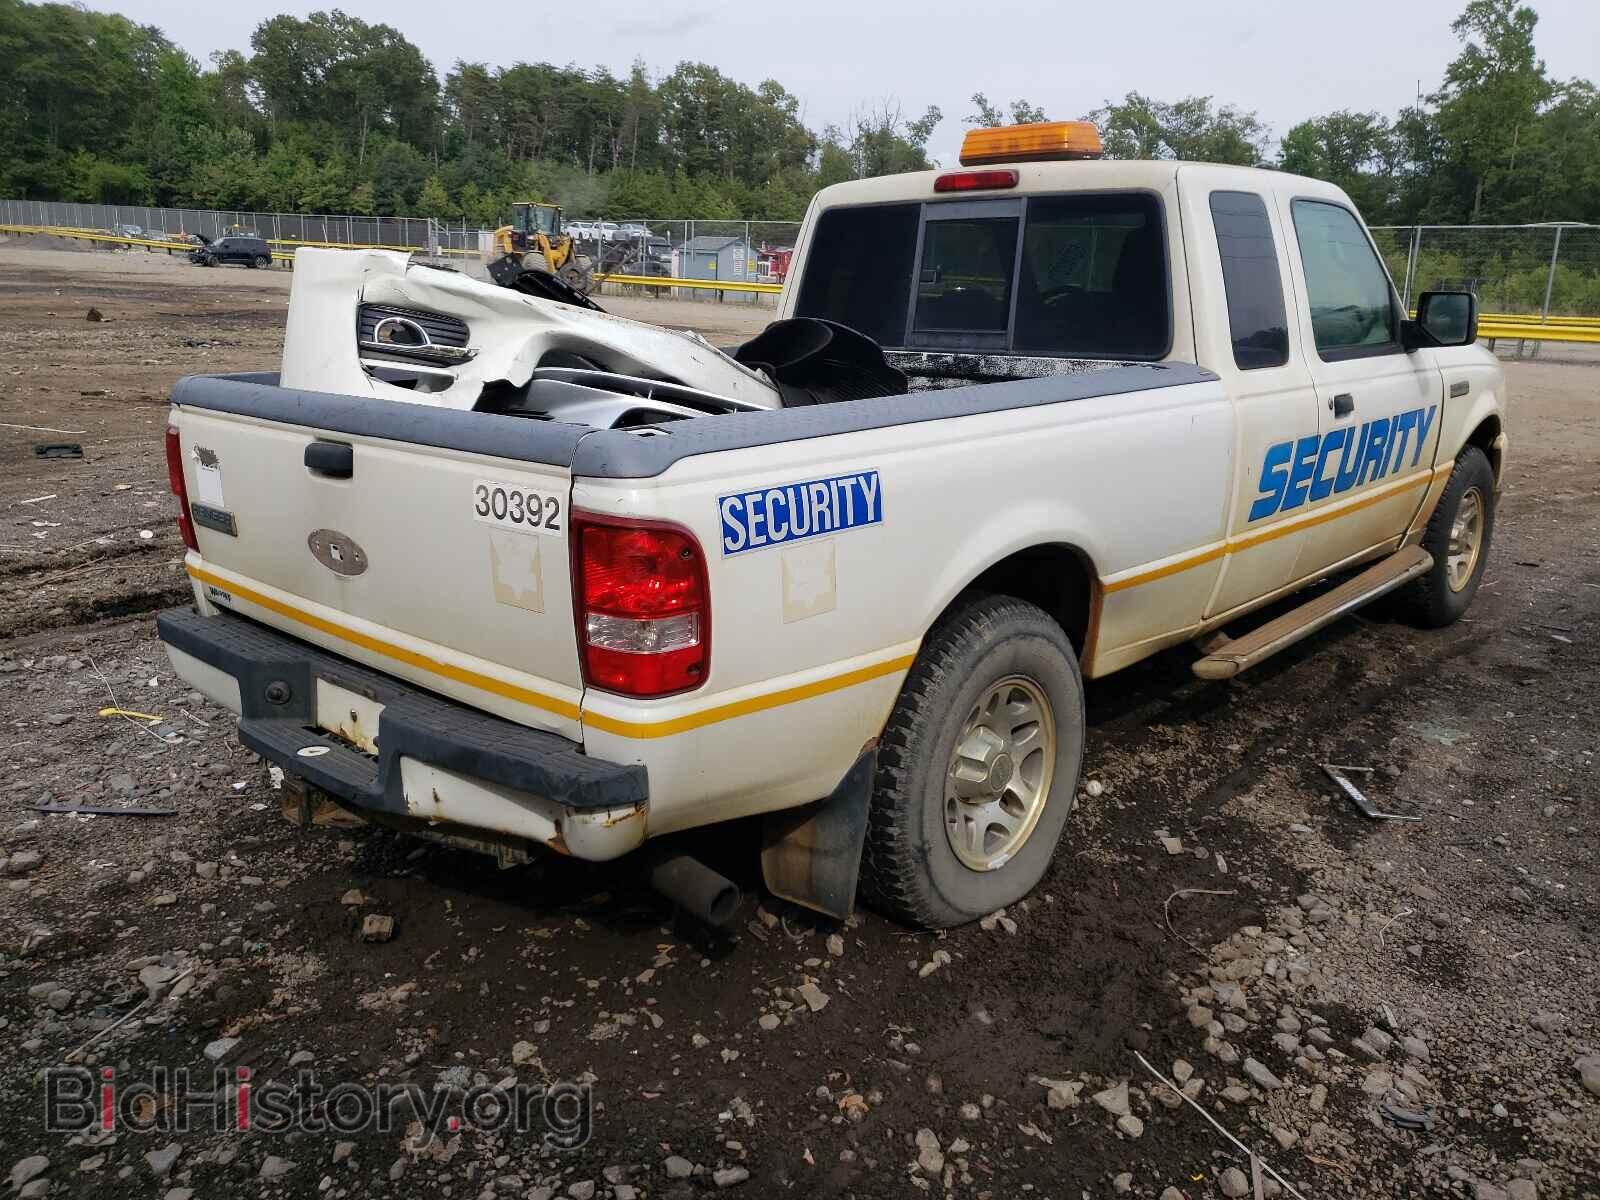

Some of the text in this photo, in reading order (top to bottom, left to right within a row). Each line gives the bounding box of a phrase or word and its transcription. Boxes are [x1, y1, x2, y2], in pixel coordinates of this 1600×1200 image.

[1248, 405, 1437, 522] SECURITY
[475, 484, 561, 531] 30392
[721, 472, 881, 552] SECURITY
